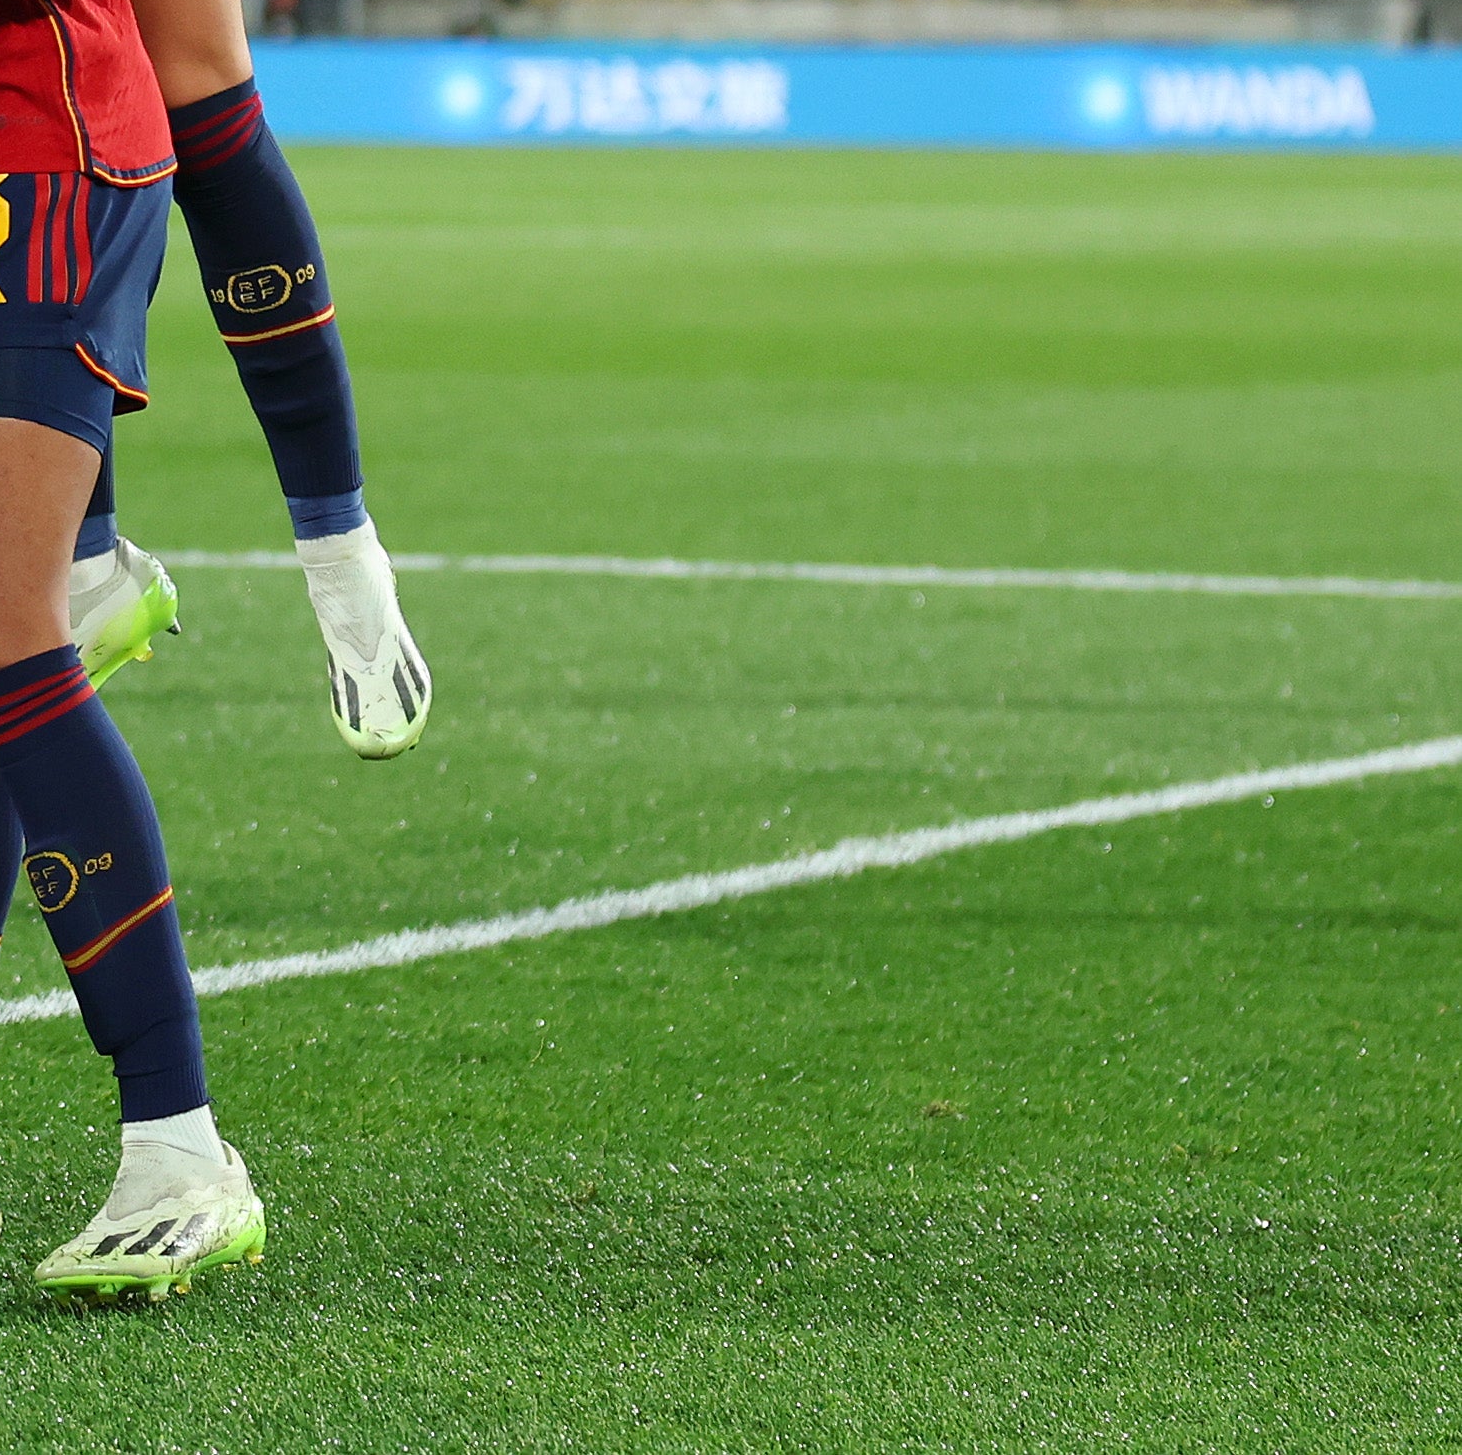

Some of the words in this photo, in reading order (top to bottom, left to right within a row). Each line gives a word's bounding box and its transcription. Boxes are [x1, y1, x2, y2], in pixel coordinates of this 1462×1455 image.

[1140, 64, 1376, 140] WANDA
[210, 288, 226, 304] 19
[295, 263, 316, 285] 09
[83, 852, 114, 876] 09
